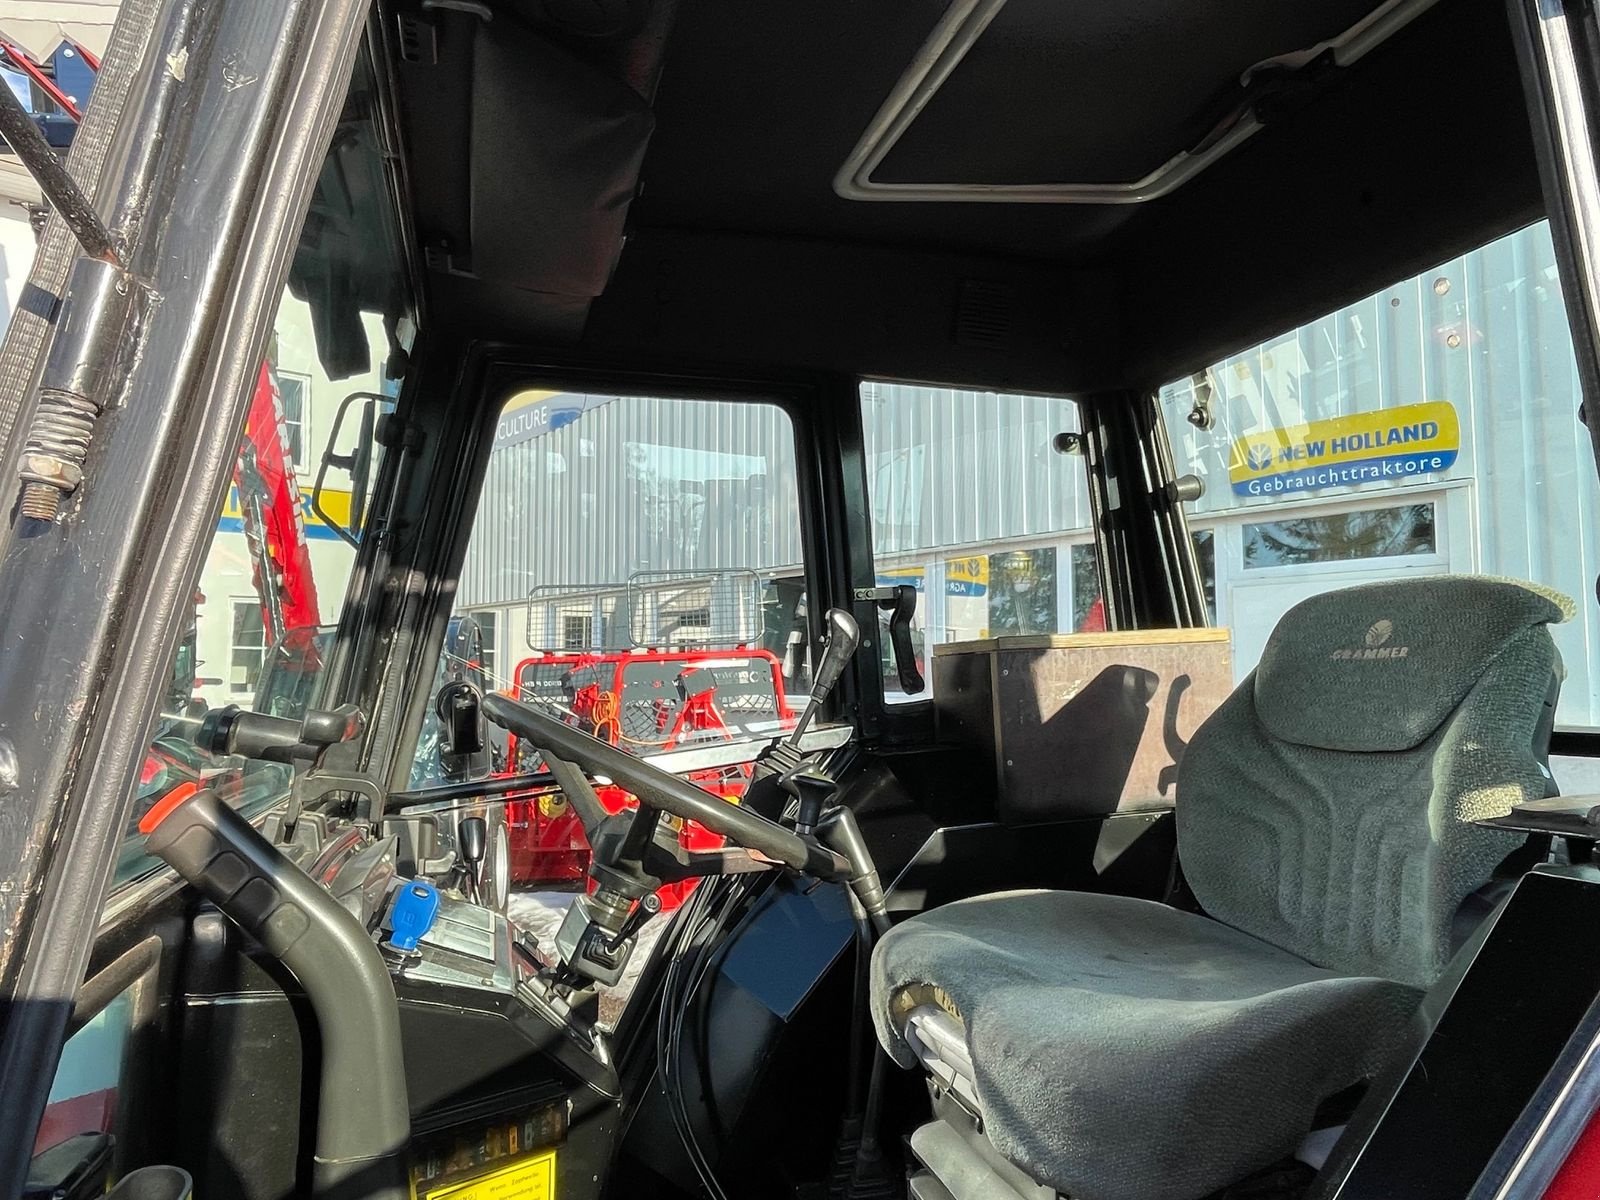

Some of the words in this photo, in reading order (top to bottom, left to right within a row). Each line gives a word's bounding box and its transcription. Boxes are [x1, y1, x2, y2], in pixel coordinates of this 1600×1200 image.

[1278, 440, 1325, 463] NEW
[1331, 421, 1438, 454] HOLLAND
[1249, 457, 1442, 493] Gebrauchttraktore
[1330, 646, 1409, 660] GRAMMER
